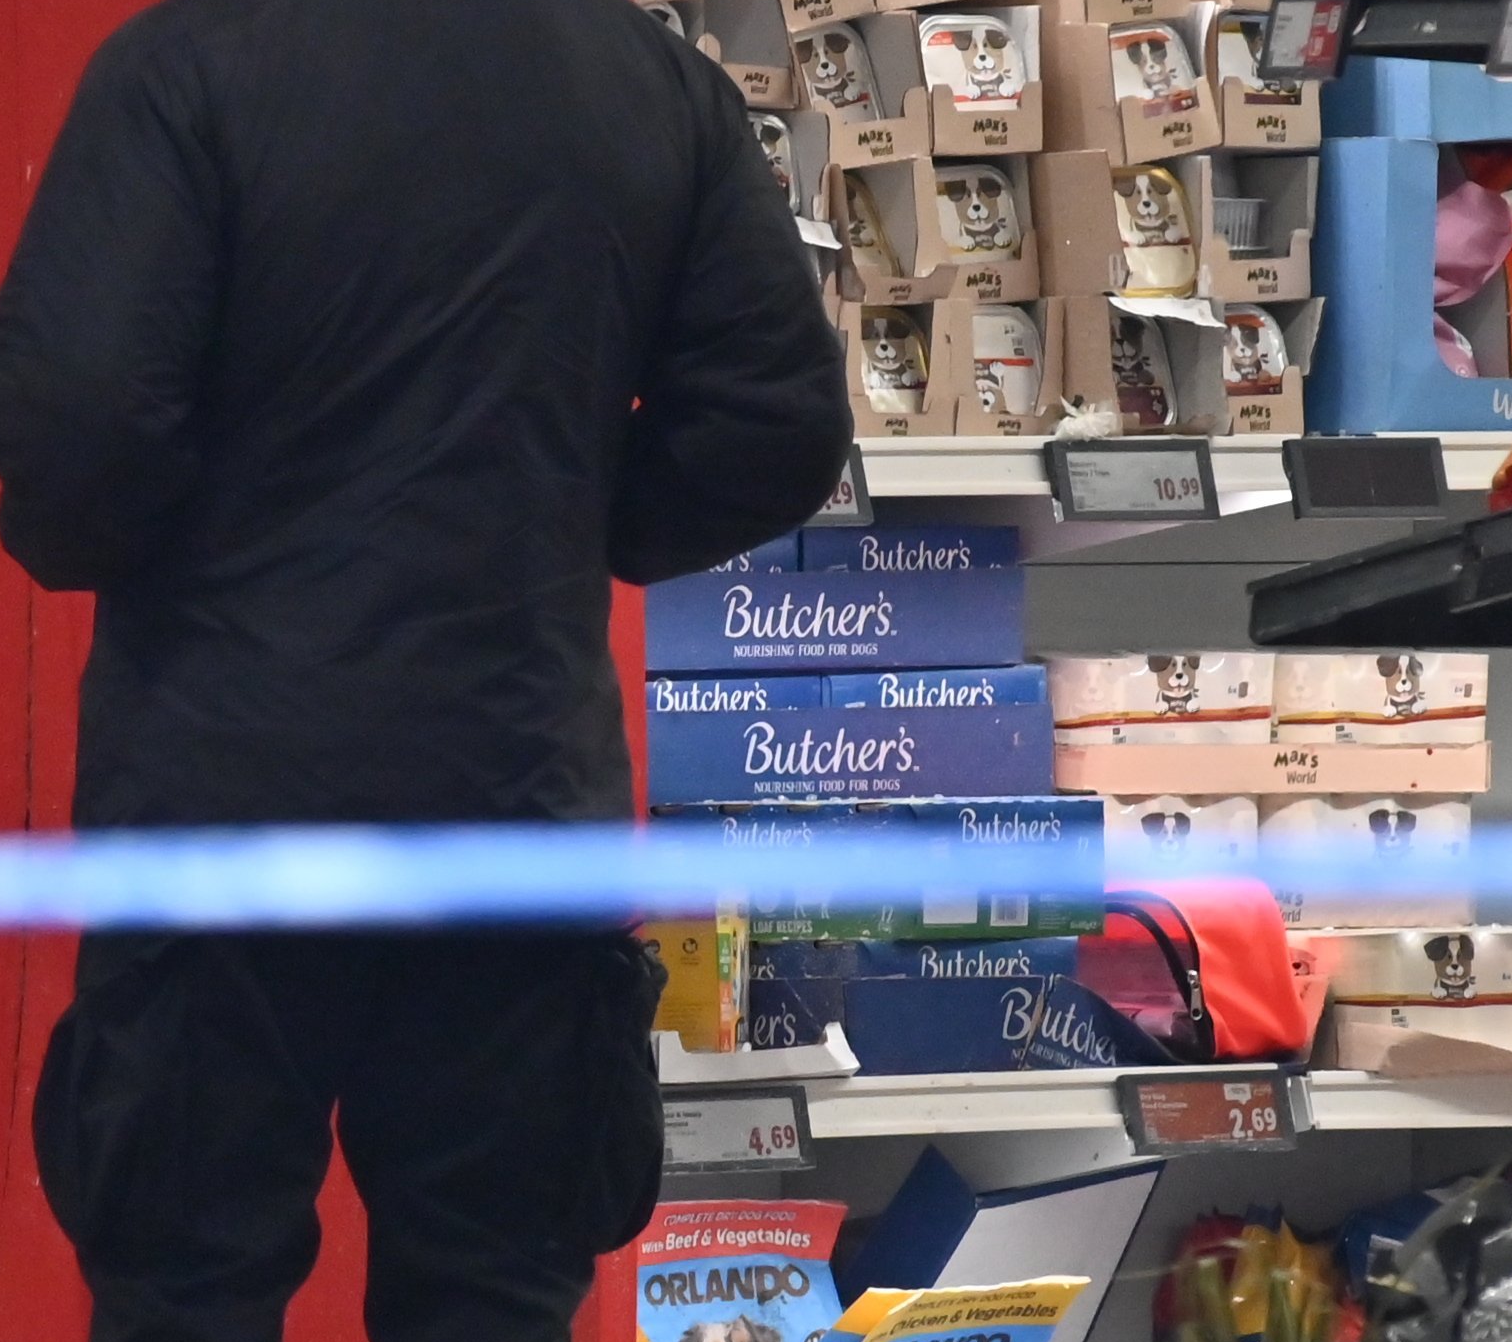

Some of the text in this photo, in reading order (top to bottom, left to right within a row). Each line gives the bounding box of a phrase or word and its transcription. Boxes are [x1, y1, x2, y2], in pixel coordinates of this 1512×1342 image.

[973, 118, 1008, 134] Max's
[1256, 115, 1287, 131] Max's
[858, 129, 893, 147] Max's
[1266, 129, 1287, 143] World
[966, 270, 1002, 288] Max's
[1247, 267, 1278, 282] Max's
[1257, 280, 1278, 294] World
[1240, 404, 1271, 420] Max's
[1249, 417, 1271, 432] World
[1153, 477, 1200, 501] 10.99
[859, 535, 972, 572] Butcher's
[723, 585, 894, 639] Butcher's
[733, 643, 879, 658] NOURISHING FOOD FOR DOGS
[653, 680, 768, 712] Butcher's
[878, 672, 995, 709] Butcher's
[744, 721, 916, 776] Butcher's
[1274, 748, 1319, 769] Max's
[754, 779, 901, 794] NOURISHING FOOD FOR DOGS
[1286, 771, 1317, 785] World
[722, 816, 814, 850] Butcher's
[958, 807, 1062, 844] Butcher's
[753, 920, 813, 934] LOAF RECIPES
[920, 944, 1031, 979] Butcher's
[1229, 1107, 1277, 1141] 2.69
[749, 1124, 796, 1156] 4.69
[664, 1213, 713, 1226] COMPLETE
[739, 1211, 763, 1221] DOG
[764, 1211, 797, 1221] FOOD
[642, 1228, 811, 1254] With Beef & Vegetables
[644, 1263, 811, 1307] ORLANDO
[890, 1303, 1059, 1336] Chicken & Vegetables
